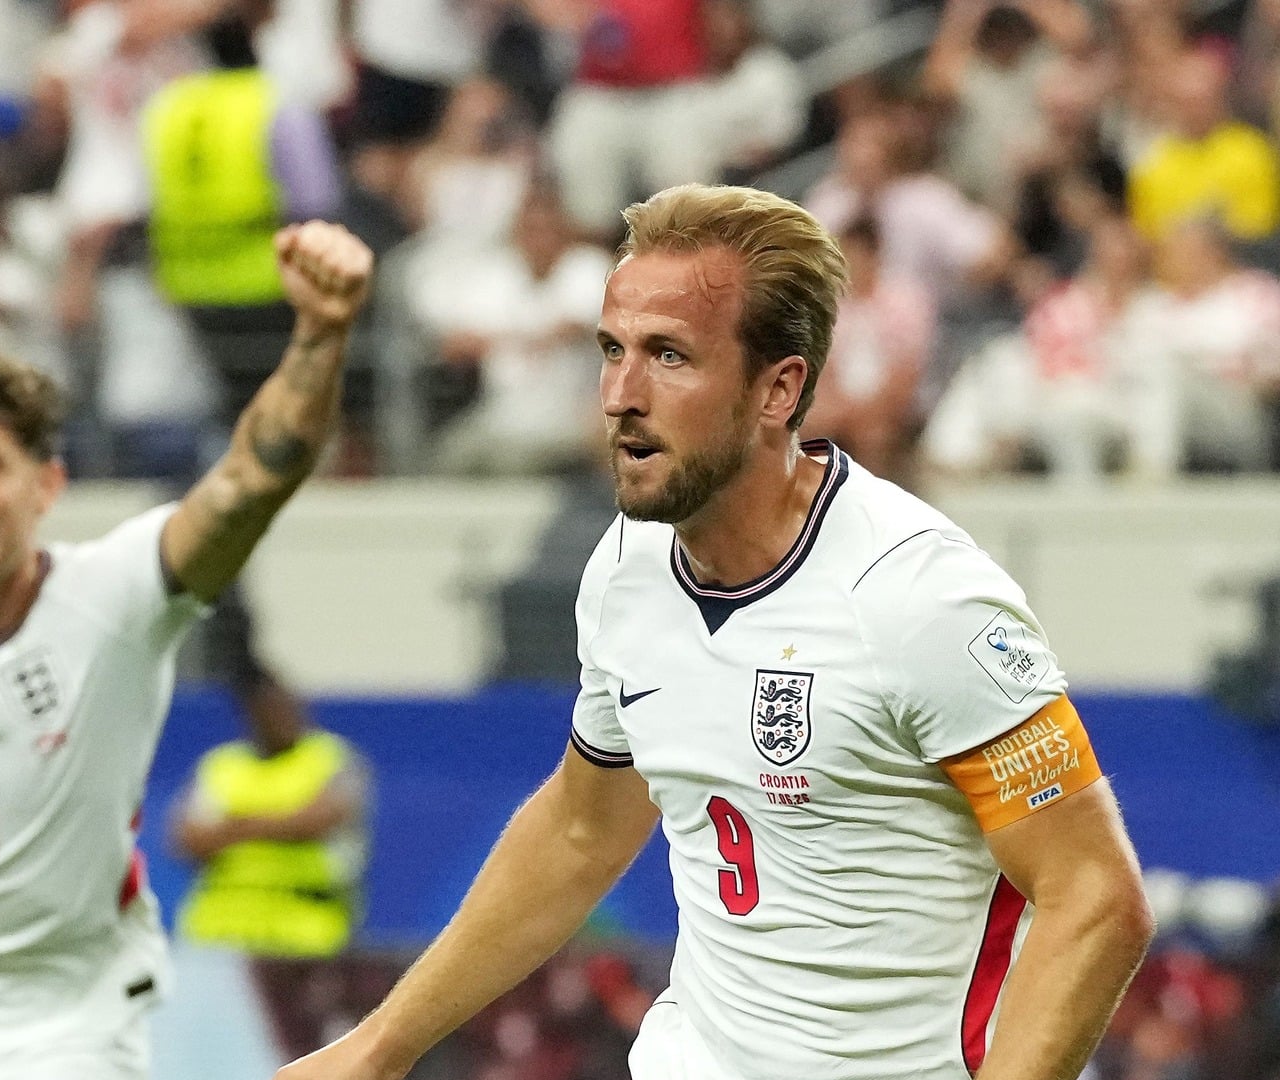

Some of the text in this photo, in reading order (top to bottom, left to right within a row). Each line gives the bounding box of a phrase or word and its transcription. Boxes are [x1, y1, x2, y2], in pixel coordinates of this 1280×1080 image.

[1010, 653, 1035, 683] PEACE
[981, 716, 1061, 763] FOOTBALL
[989, 729, 1070, 782] UNITES
[759, 773, 810, 789] CROATIA
[998, 748, 1080, 804] the World
[766, 791, 811, 805] 17.06.26
[1030, 786, 1062, 806] FIFA
[706, 795, 760, 917] 9
